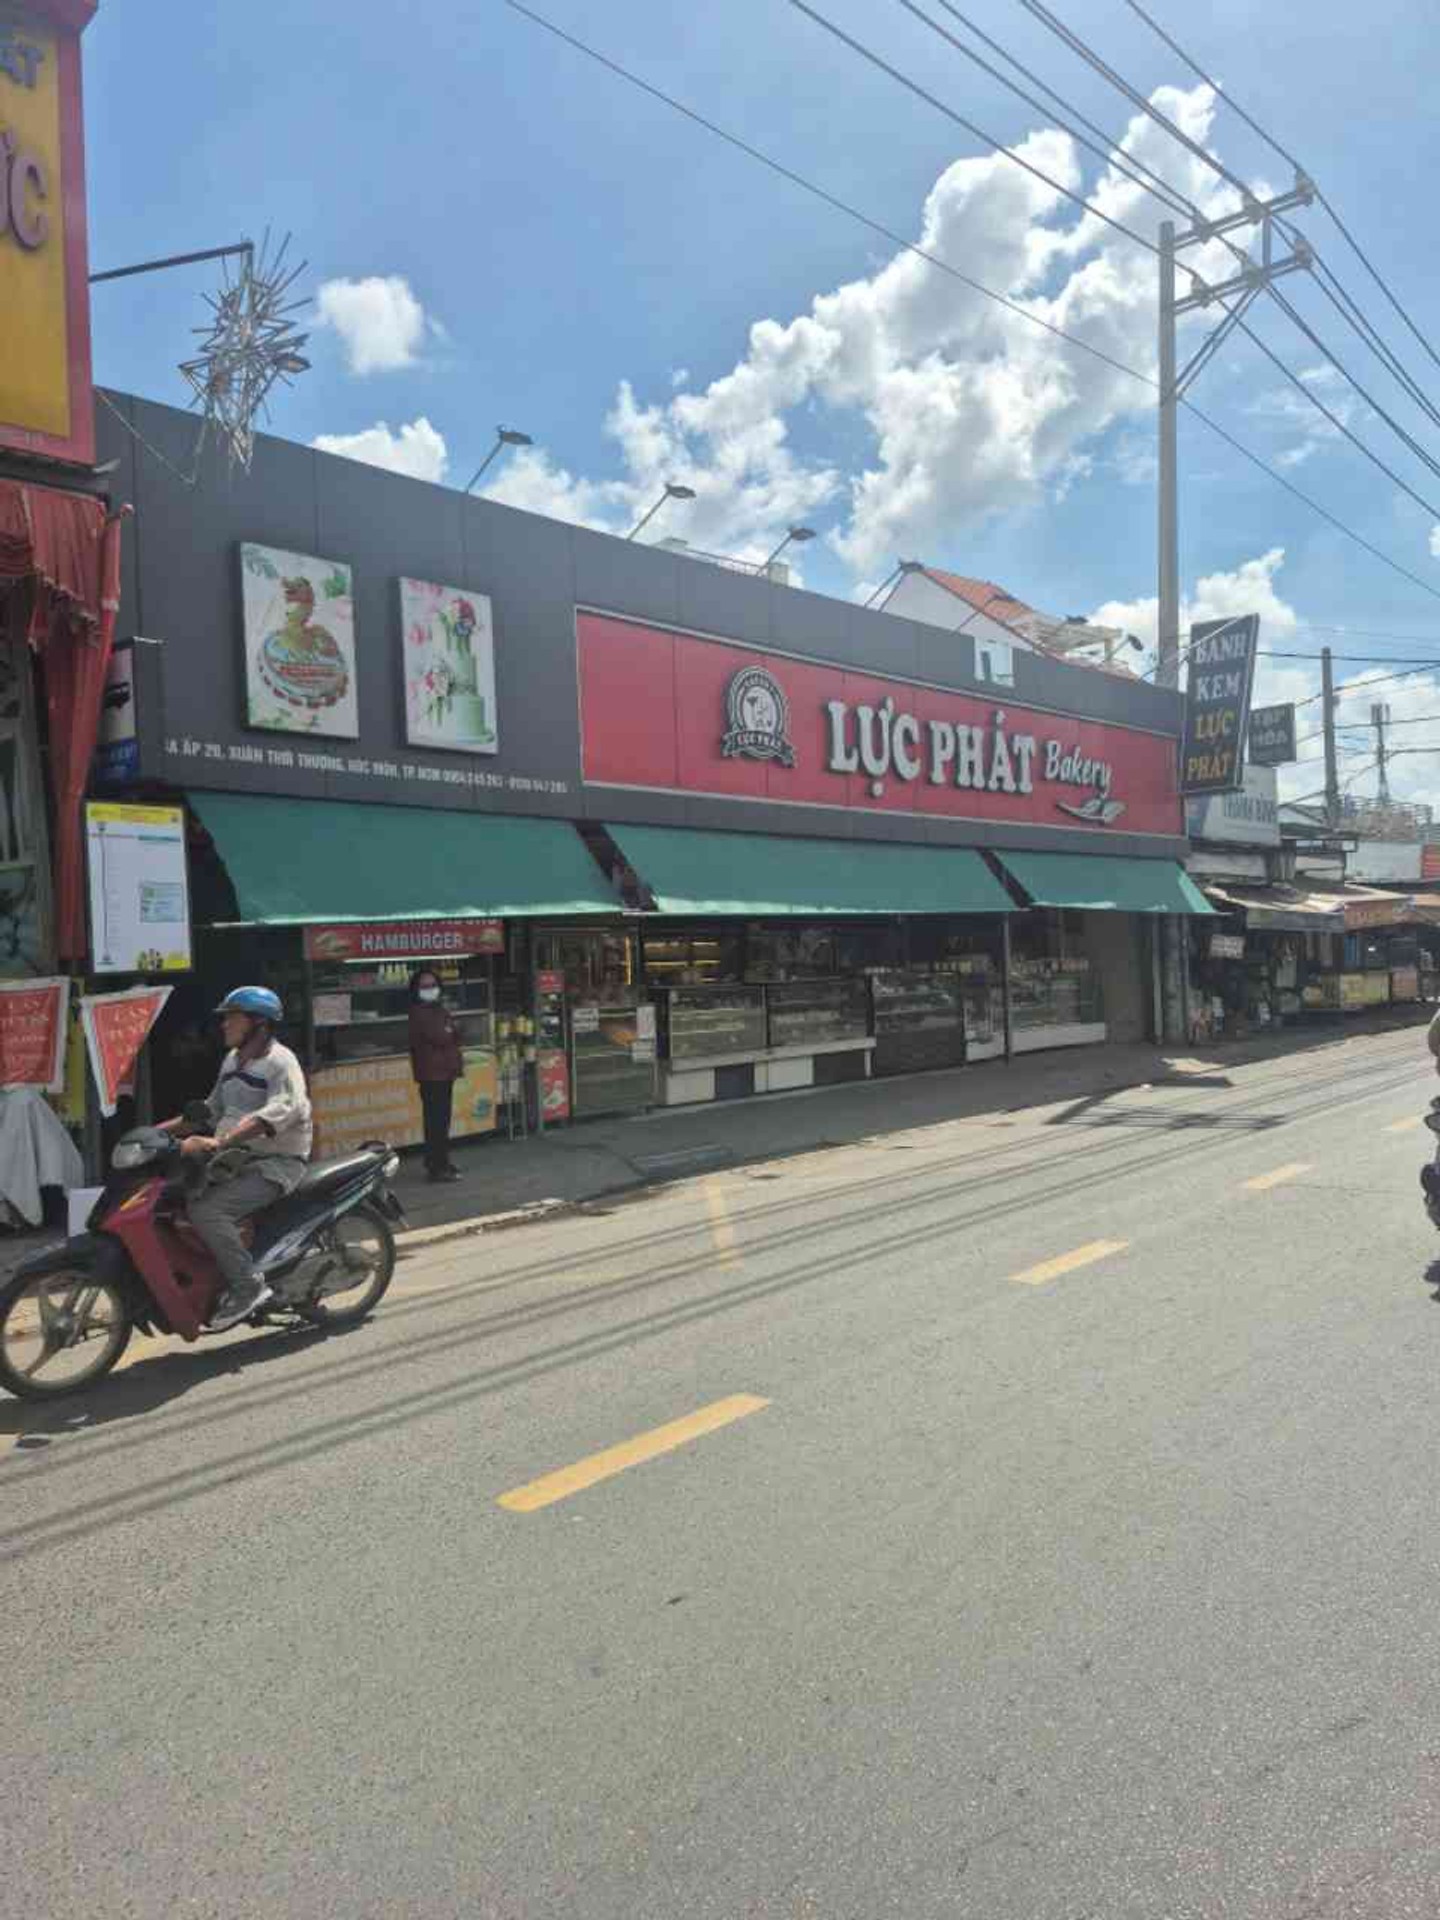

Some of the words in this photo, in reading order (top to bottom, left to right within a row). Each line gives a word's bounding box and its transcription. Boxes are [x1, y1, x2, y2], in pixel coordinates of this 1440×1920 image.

[1196, 671, 1241, 702] KEM
[826, 695, 922, 797] LỰC
[928, 710, 1036, 794] PHÁT
[1044, 739, 1112, 798] Bakery
[360, 932, 465, 951] HAMBURGER
